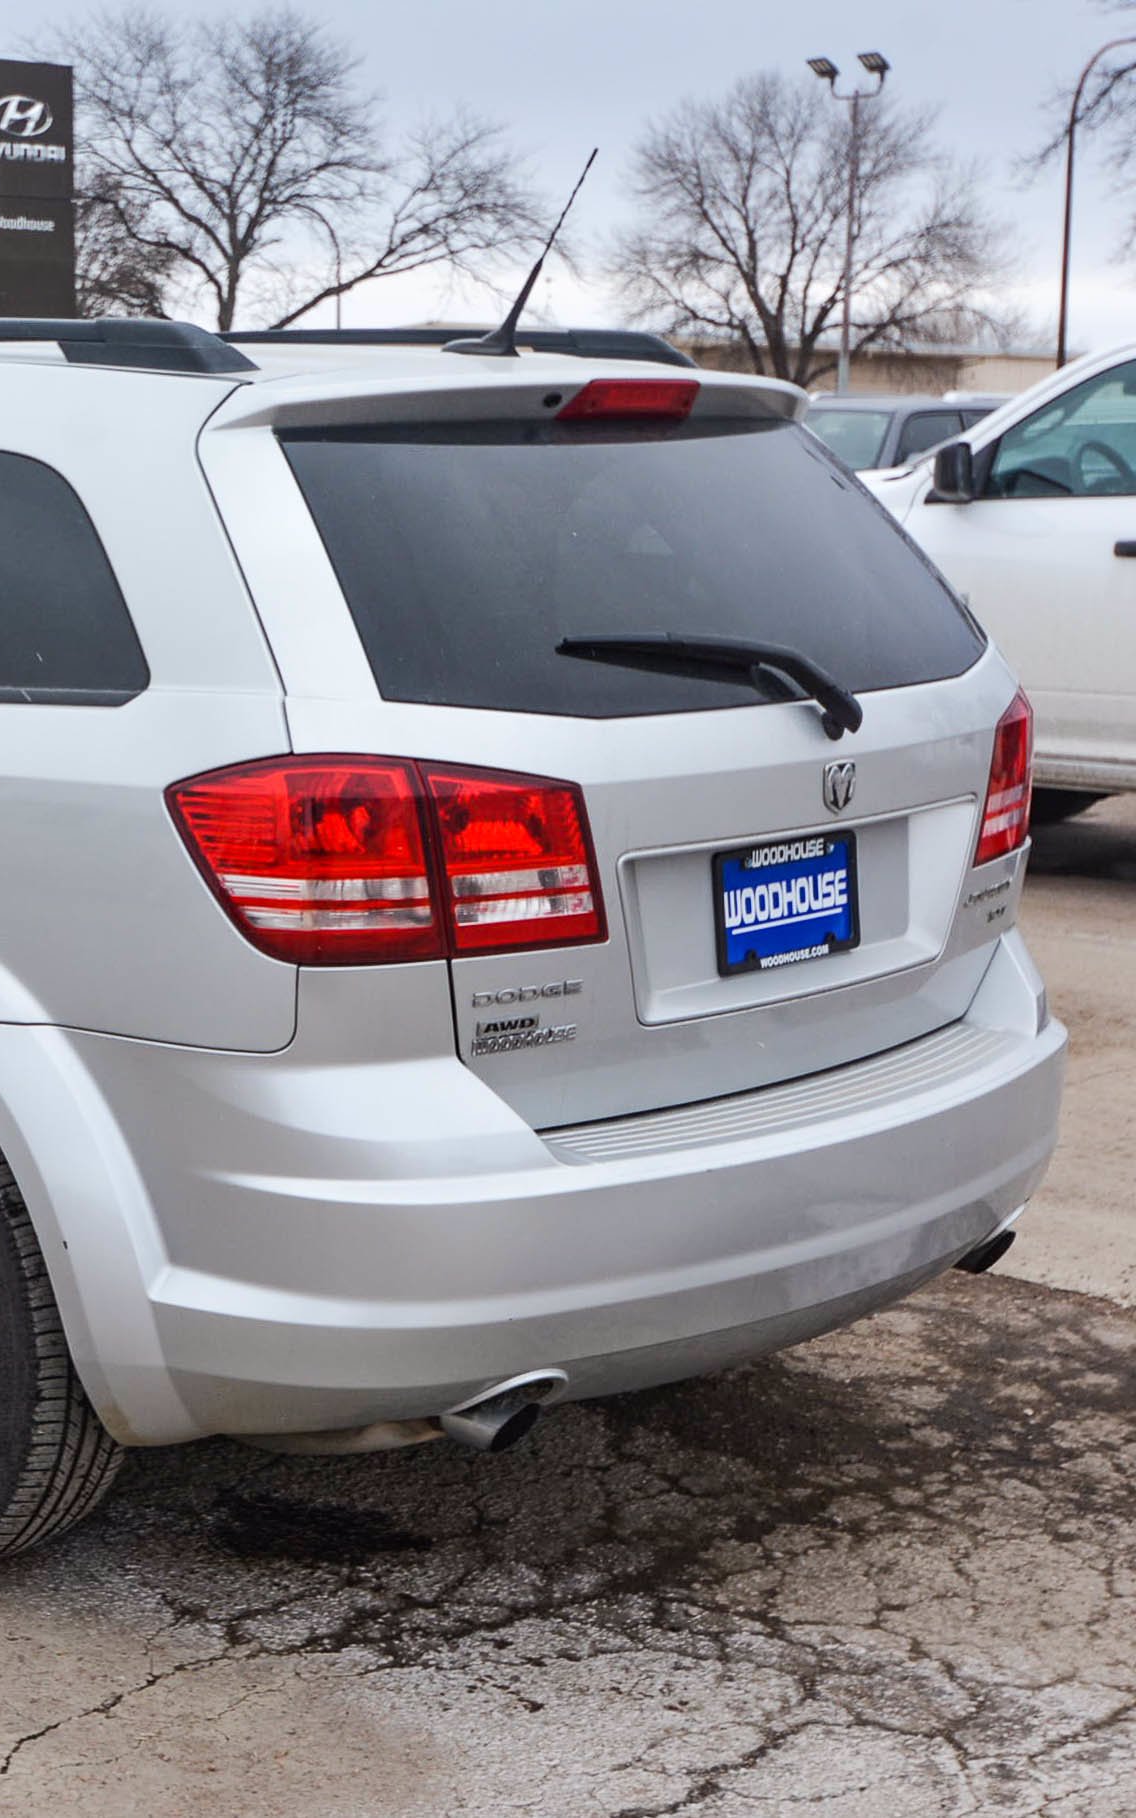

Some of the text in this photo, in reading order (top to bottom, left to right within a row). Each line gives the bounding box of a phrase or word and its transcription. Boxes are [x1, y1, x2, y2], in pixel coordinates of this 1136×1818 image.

[752, 838, 824, 868] WOODHOUSE
[724, 869, 848, 928] WOODHOUSE
[760, 944, 829, 968] WOODHOUSE.COM
[472, 979, 584, 1008] DODGE
[484, 1017, 535, 1034] AWD
